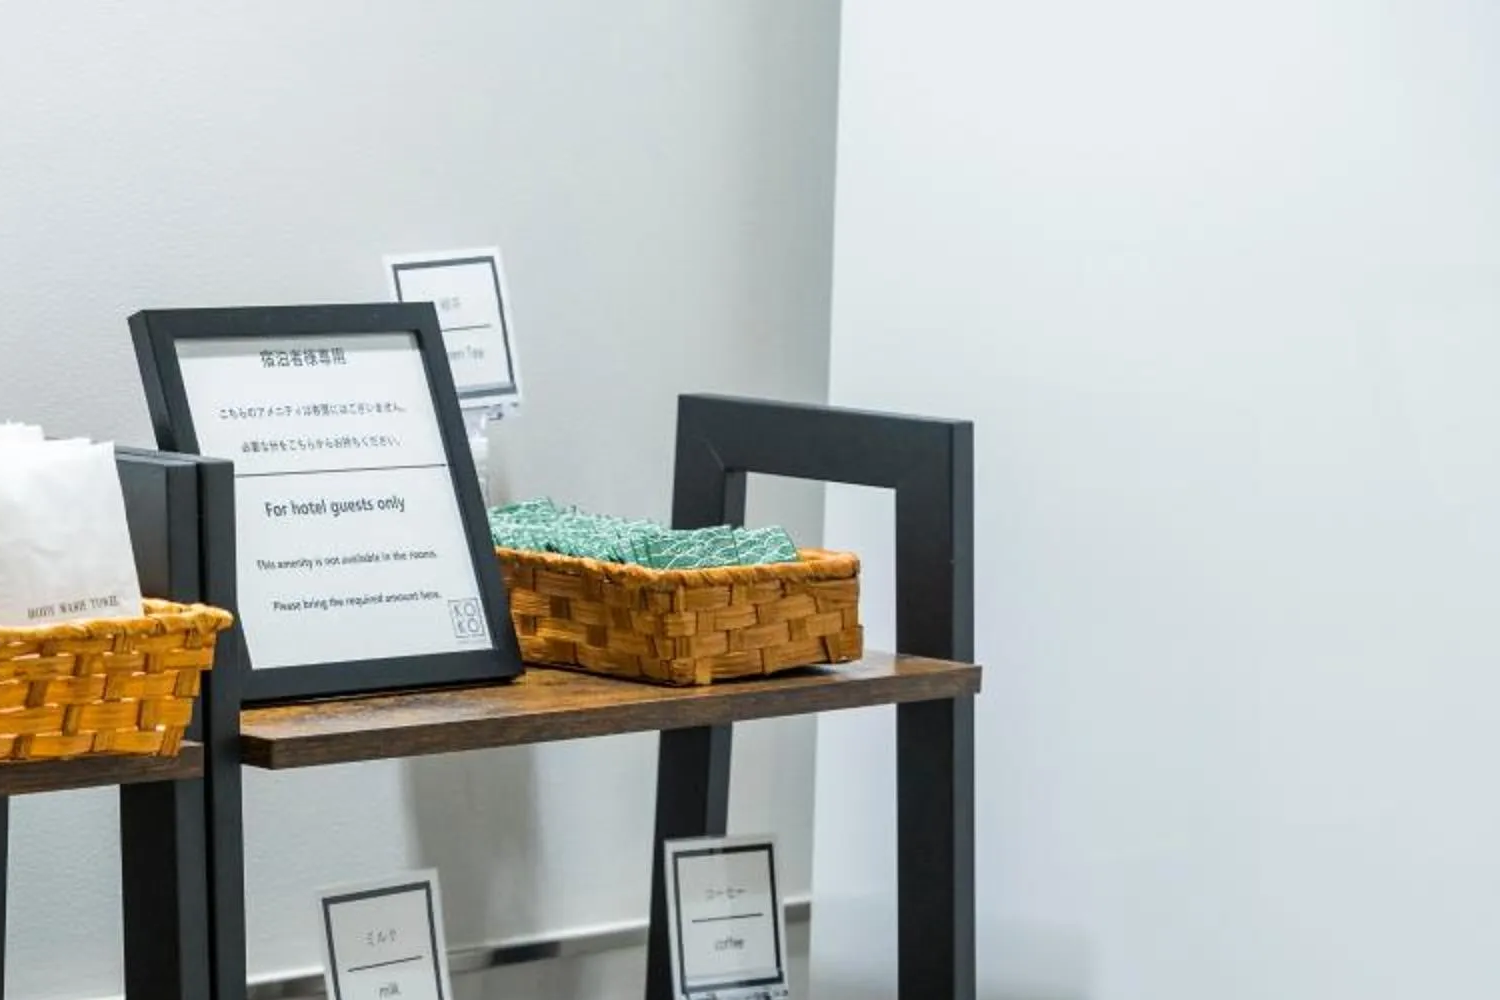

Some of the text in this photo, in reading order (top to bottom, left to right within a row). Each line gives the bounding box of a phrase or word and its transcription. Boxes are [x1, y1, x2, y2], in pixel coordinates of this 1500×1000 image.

[264, 495, 405, 518] For hotel guests only
[256, 558, 276, 570] This
[277, 557, 313, 570] amenity
[324, 556, 340, 566] not
[341, 551, 380, 566] available
[392, 550, 407, 561] the
[27, 595, 120, 620] BODY WASH TOWEL
[273, 600, 301, 612] Please
[303, 598, 328, 611] bring
[329, 597, 345, 607] the
[346, 593, 383, 609] required
[384, 592, 419, 604] amount
[453, 602, 477, 618] KO
[456, 617, 482, 634] KO
